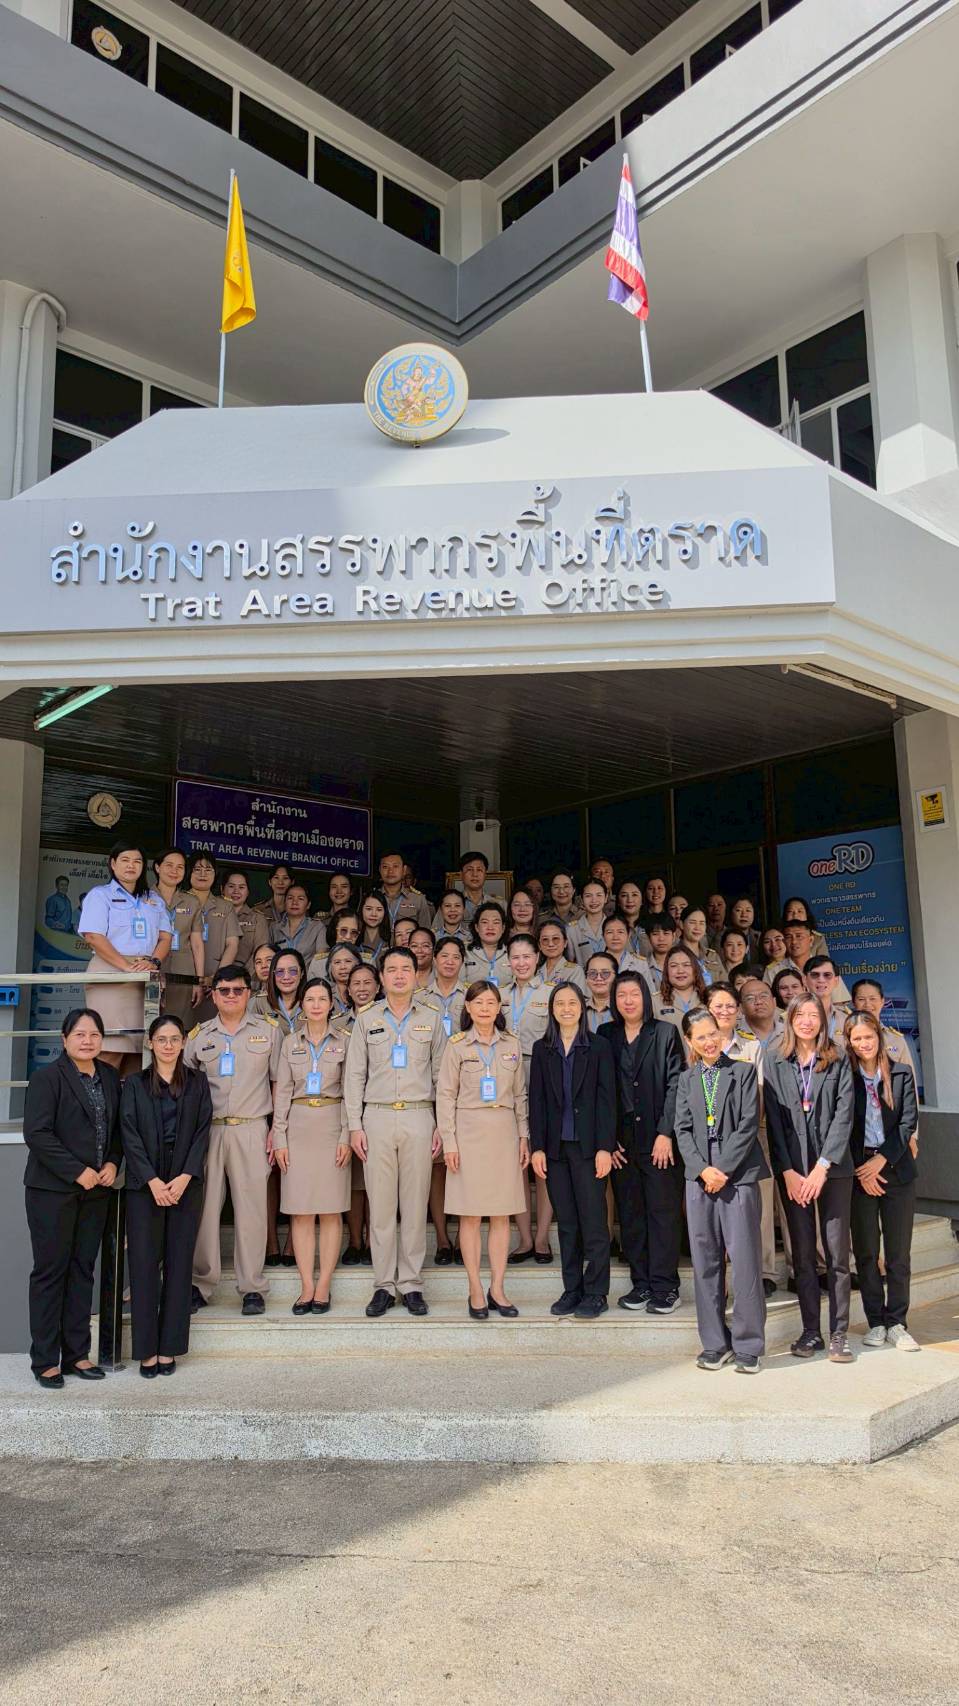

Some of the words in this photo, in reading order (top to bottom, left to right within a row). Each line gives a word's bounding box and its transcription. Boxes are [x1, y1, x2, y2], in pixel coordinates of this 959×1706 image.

[49, 484, 764, 584] สำนักงานสรรพากรพื้นที่ตราด
[140, 591, 222, 620] Trat
[240, 588, 335, 618] Area
[355, 584, 518, 613] Revenue
[541, 576, 666, 607] Office
[251, 798, 308, 818] สำนักงาน
[181, 814, 365, 851] สรรพากรพื้นที่สาขาเมืองตราด
[190, 840, 216, 852] TRAT
[218, 843, 244, 856] AREA
[247, 847, 289, 861] REVENUE
[291, 852, 328, 866] BRANCH
[330, 857, 360, 869] OFFICE
